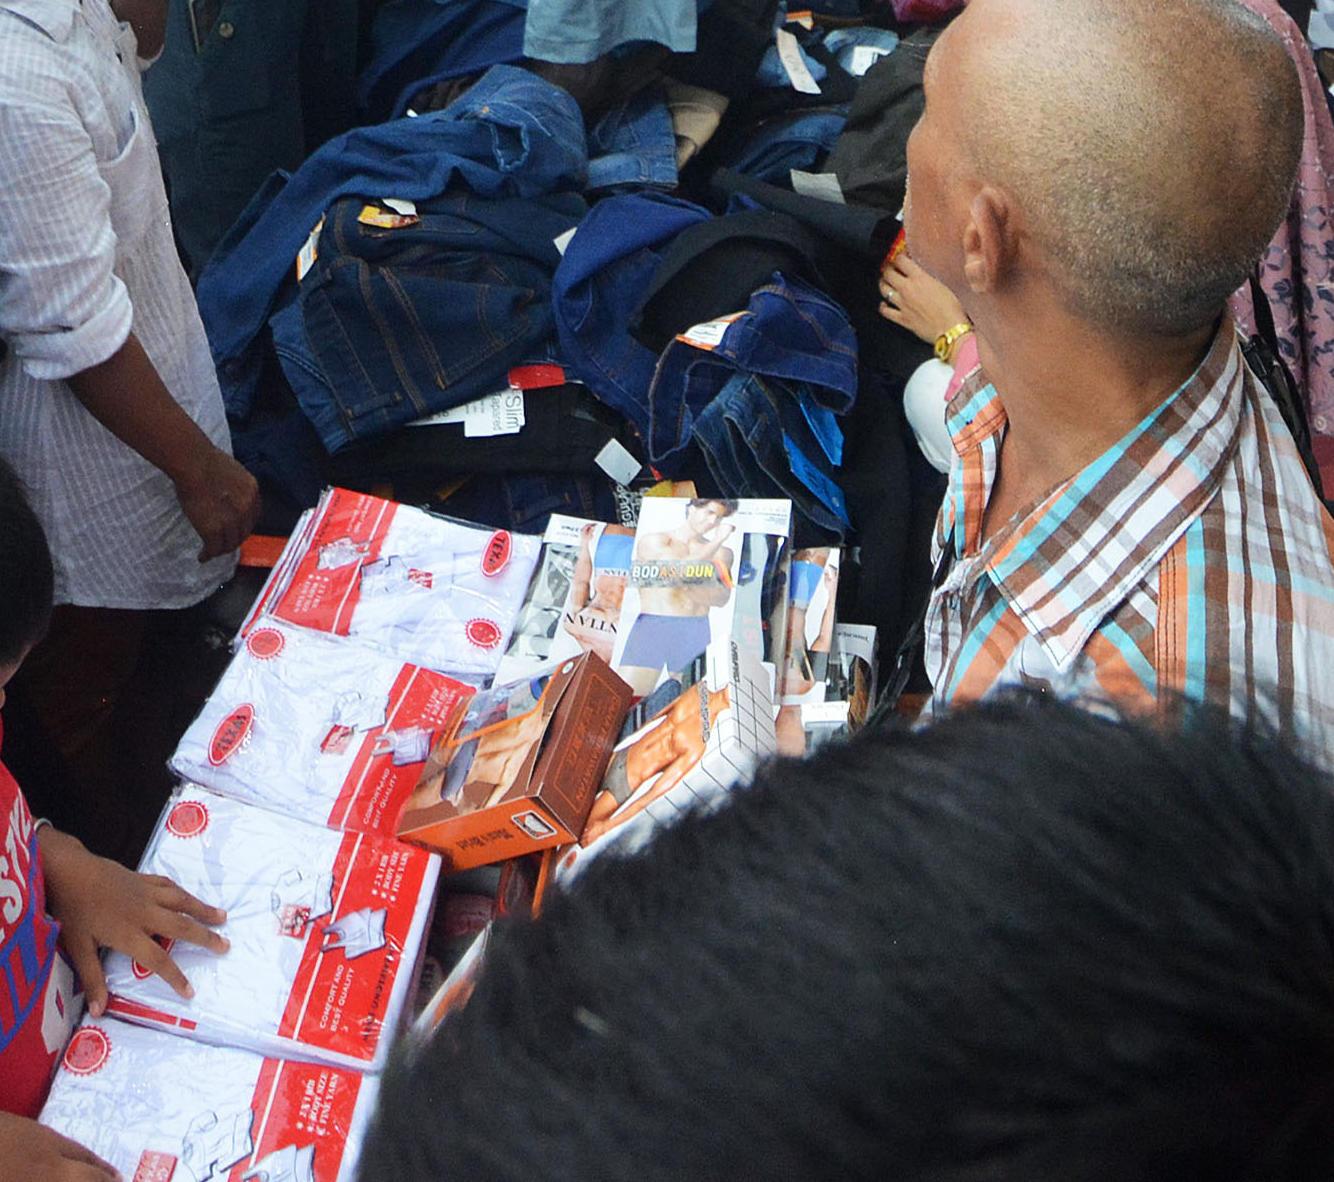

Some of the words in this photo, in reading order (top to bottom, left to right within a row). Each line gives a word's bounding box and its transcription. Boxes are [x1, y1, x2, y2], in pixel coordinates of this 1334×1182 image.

[505, 395, 523, 429] Slim
[379, 774, 398, 810] QUALITY
[319, 982, 340, 1030] COMFORT
[334, 964, 345, 982] AND
[330, 1007, 343, 1032] BEST
[338, 967, 355, 1006] QUALITY
